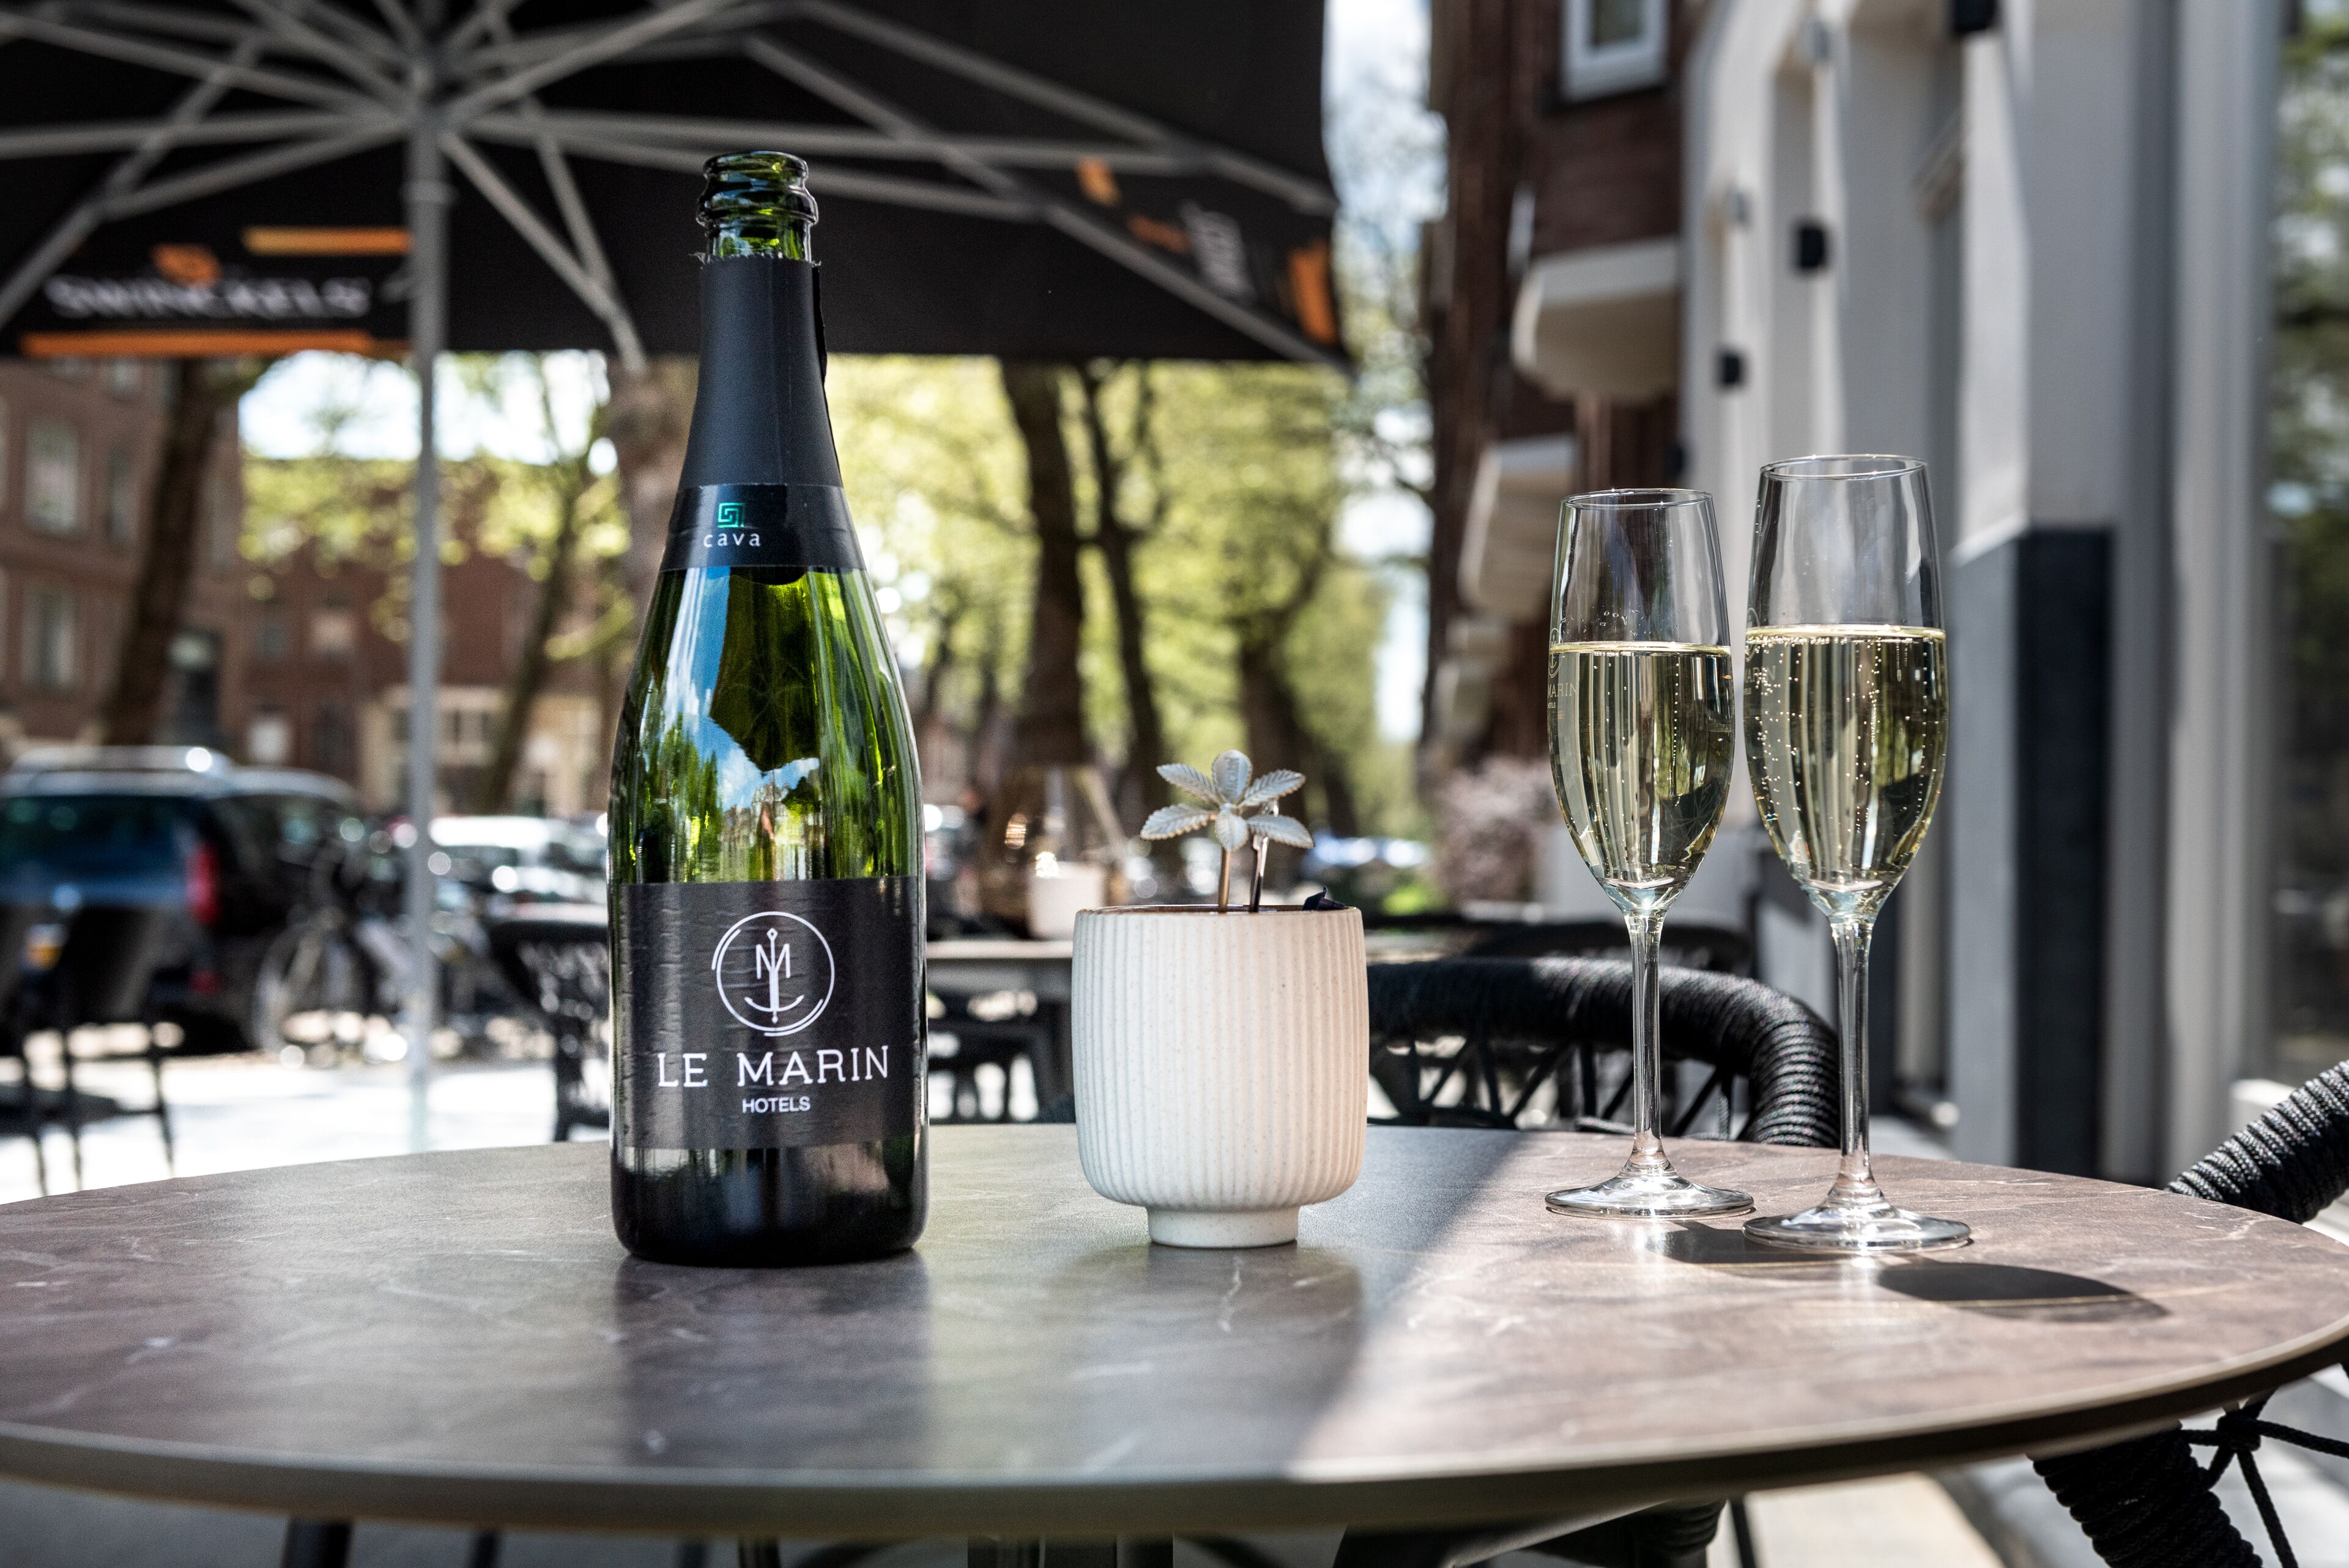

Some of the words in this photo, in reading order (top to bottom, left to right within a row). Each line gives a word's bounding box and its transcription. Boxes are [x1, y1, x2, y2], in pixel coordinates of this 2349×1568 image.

[703, 532, 761, 548] cava
[657, 1053, 708, 1087] LE
[737, 1045, 888, 1087] MARIN
[741, 1096, 811, 1114] HOTELS
